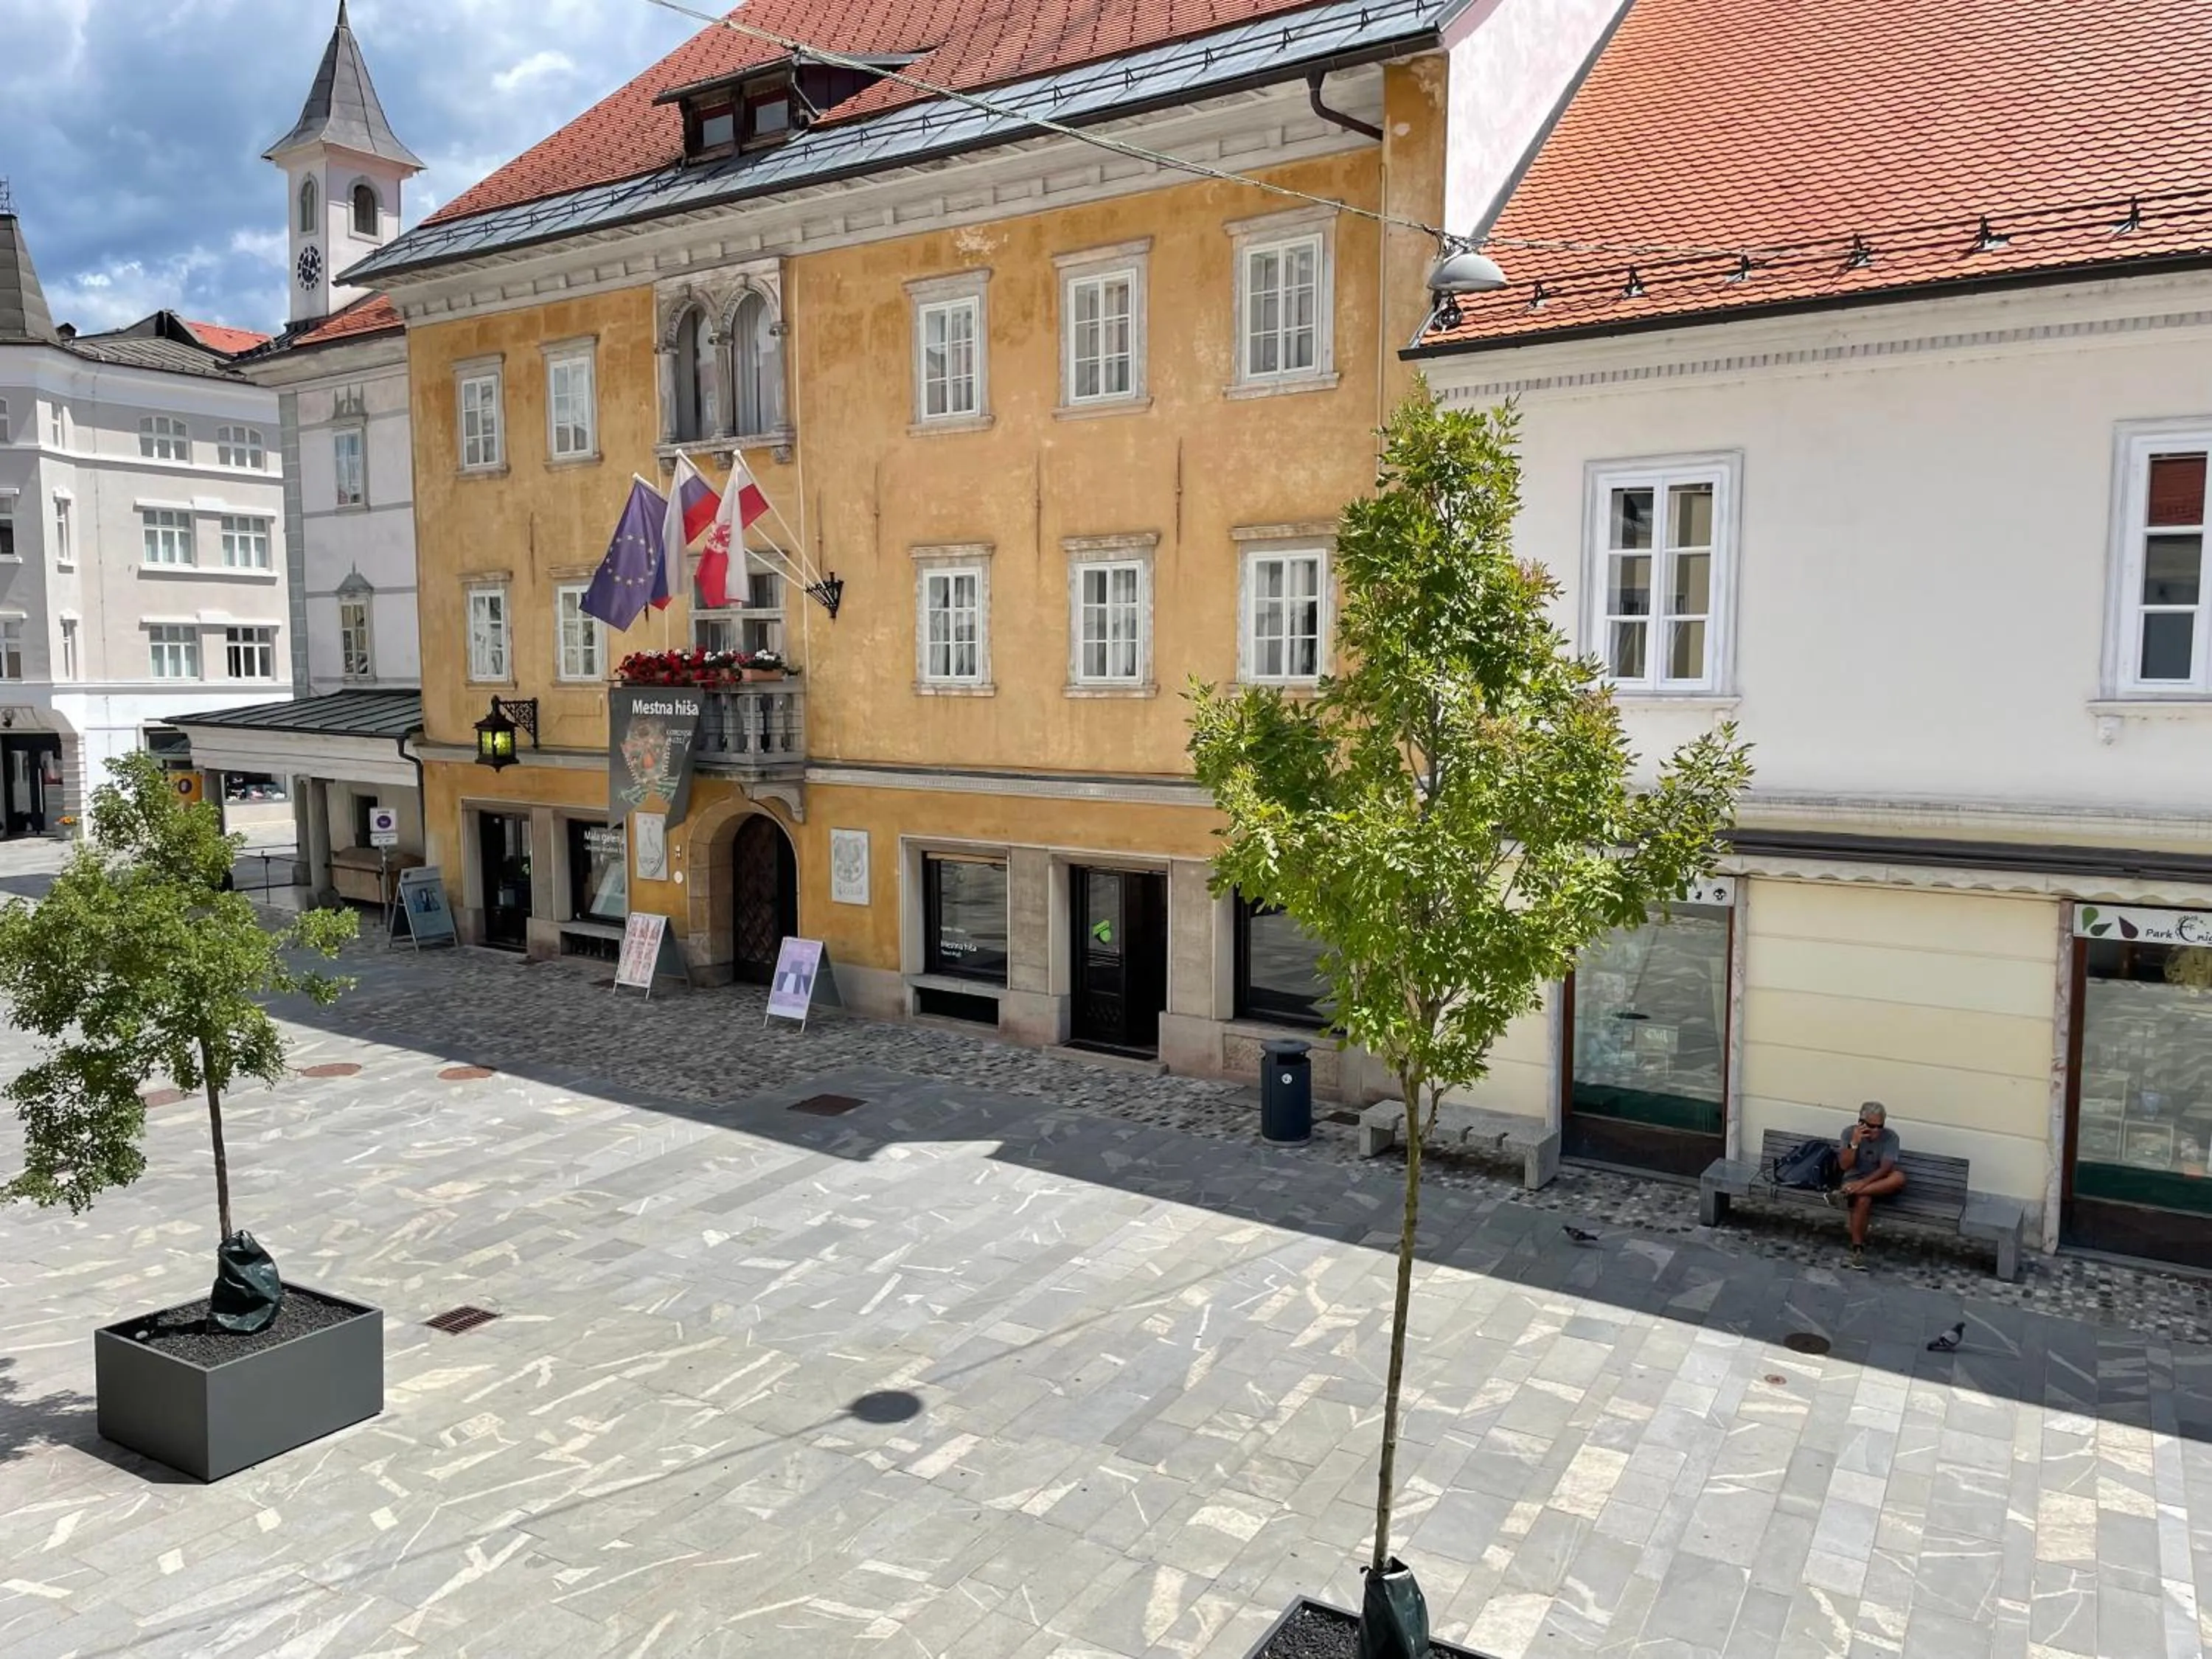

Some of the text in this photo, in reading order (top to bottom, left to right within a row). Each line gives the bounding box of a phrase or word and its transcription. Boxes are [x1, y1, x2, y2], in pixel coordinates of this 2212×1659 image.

[632, 698, 700, 716] Mestna hiša
[2145, 928, 2172, 939] Park
